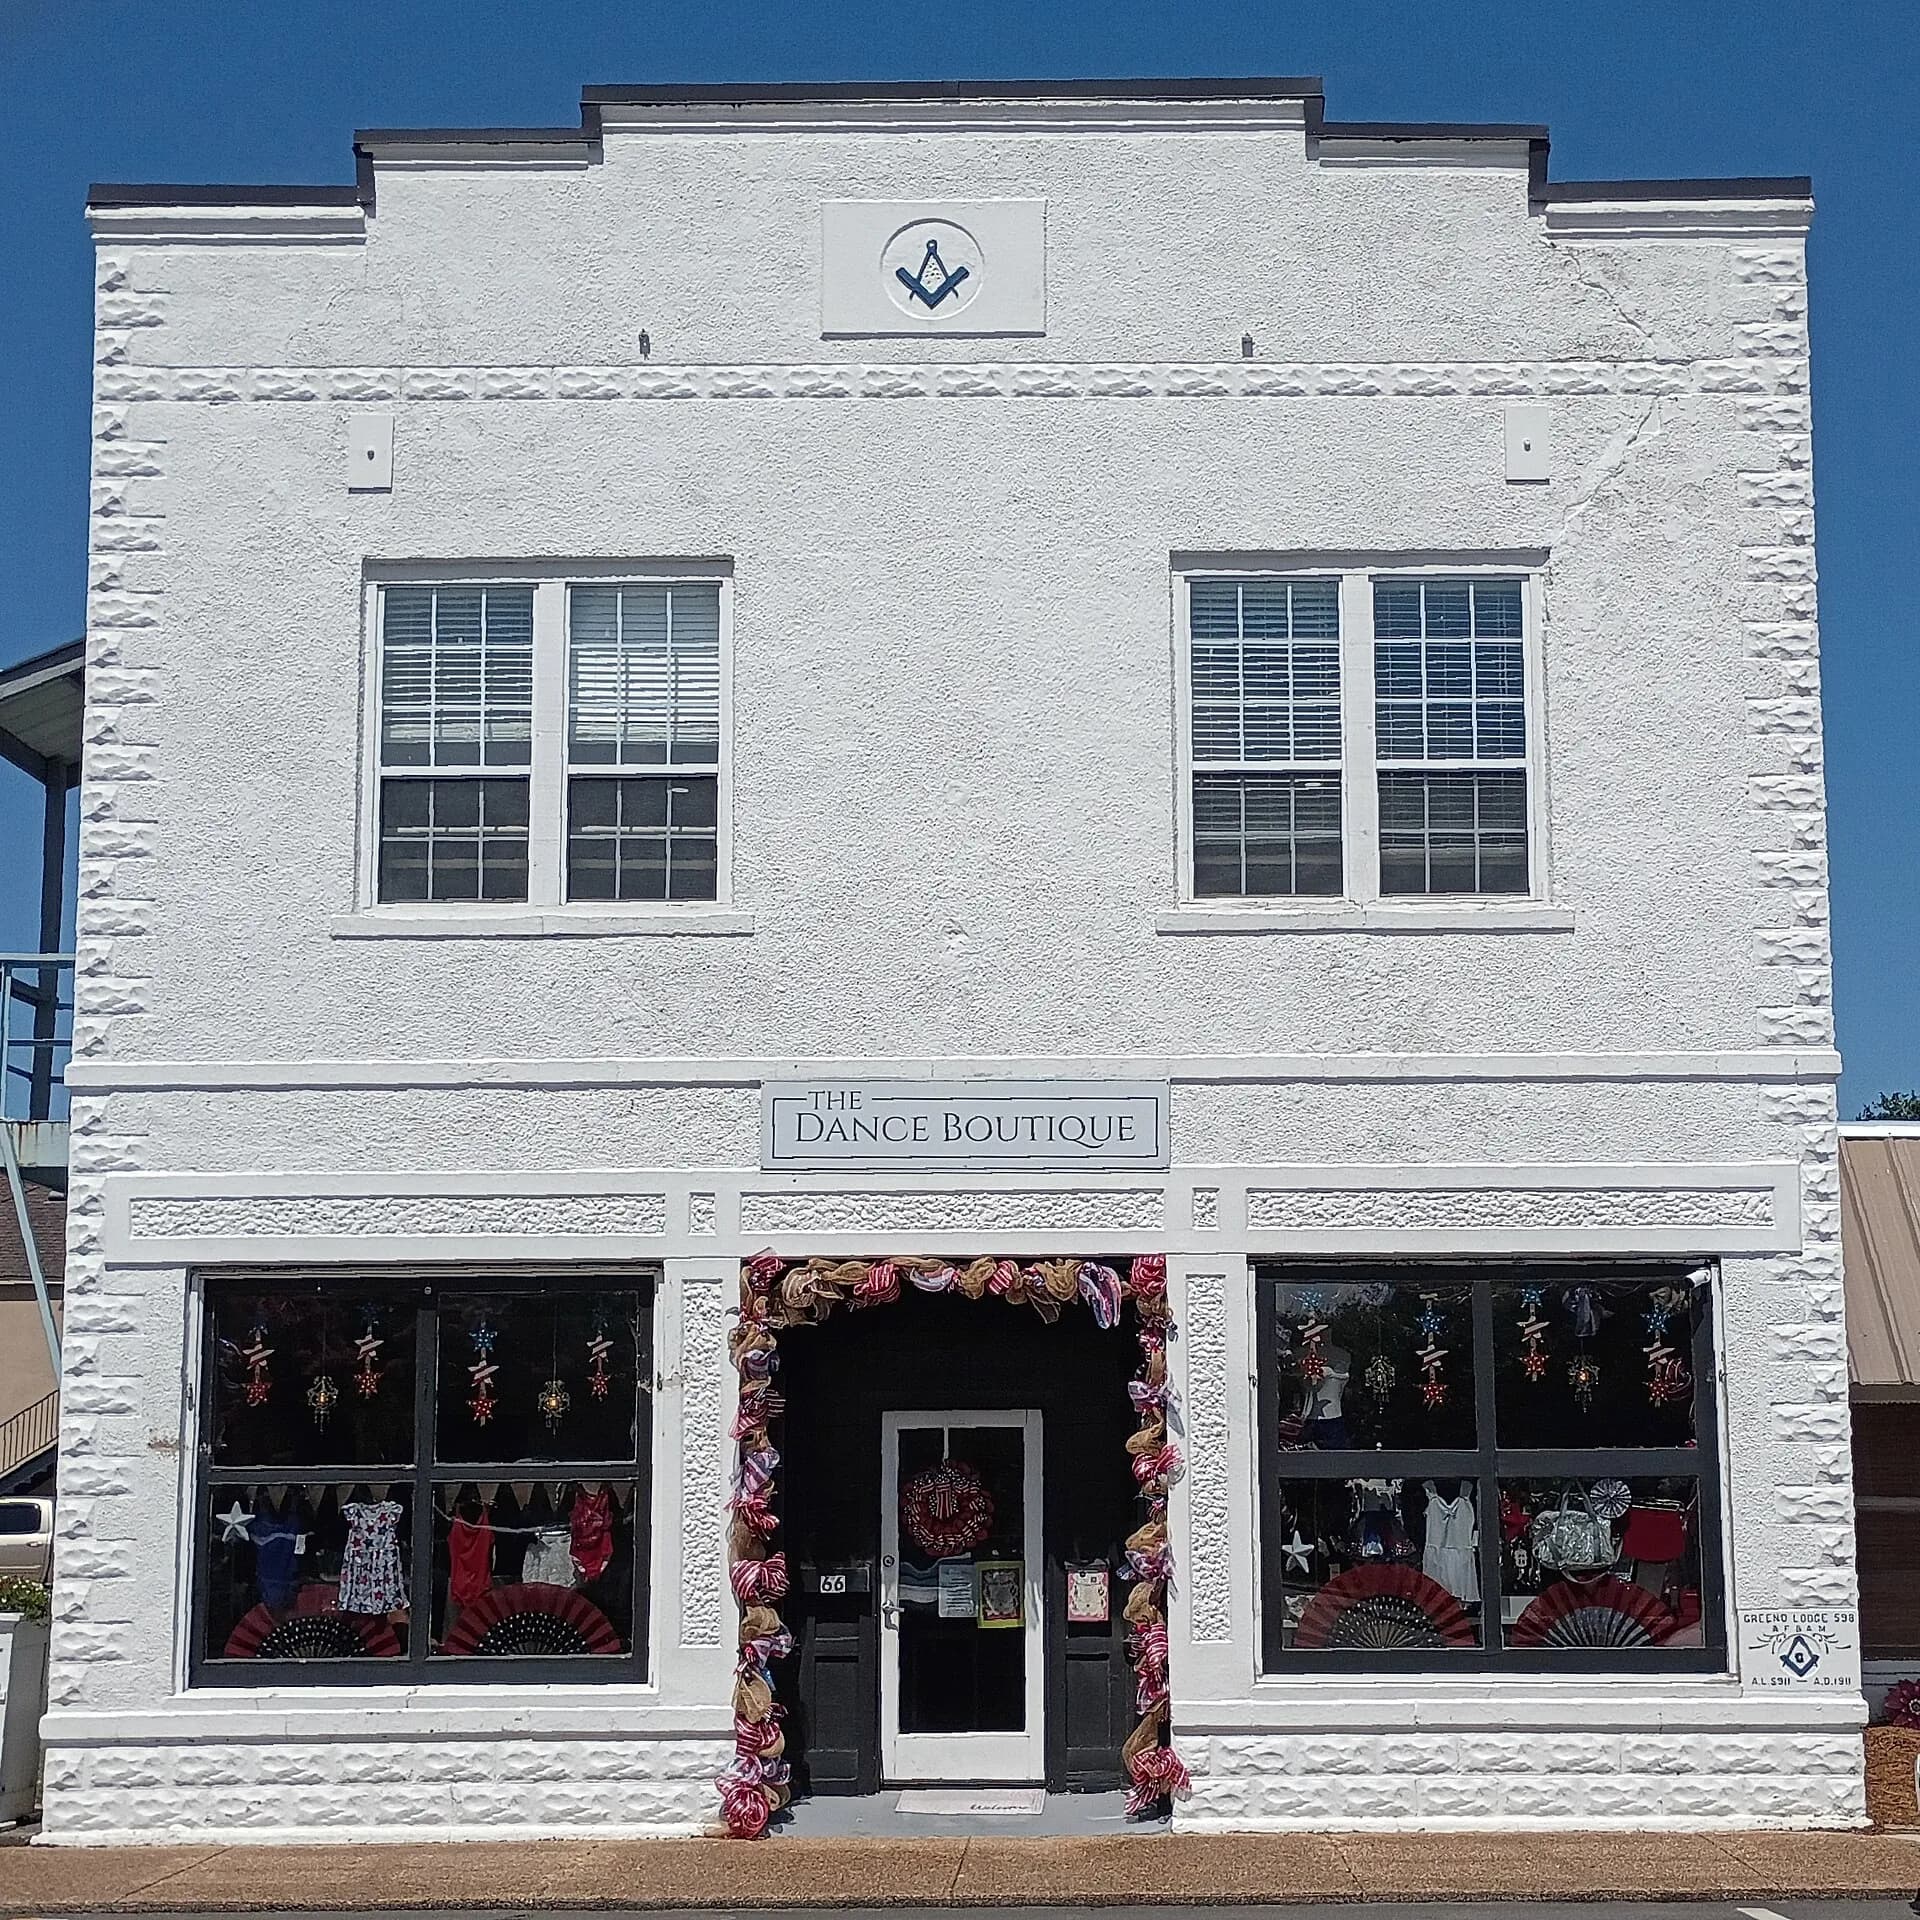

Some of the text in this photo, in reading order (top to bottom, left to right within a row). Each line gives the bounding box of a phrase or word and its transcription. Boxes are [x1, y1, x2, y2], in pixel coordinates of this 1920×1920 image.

[807, 1090, 863, 1111] THE
[794, 1112, 1137, 1149] DANCE BOUTIQUE
[822, 1576, 844, 1592] 66
[1743, 1613, 1855, 1623] GREENO LODGE 598
